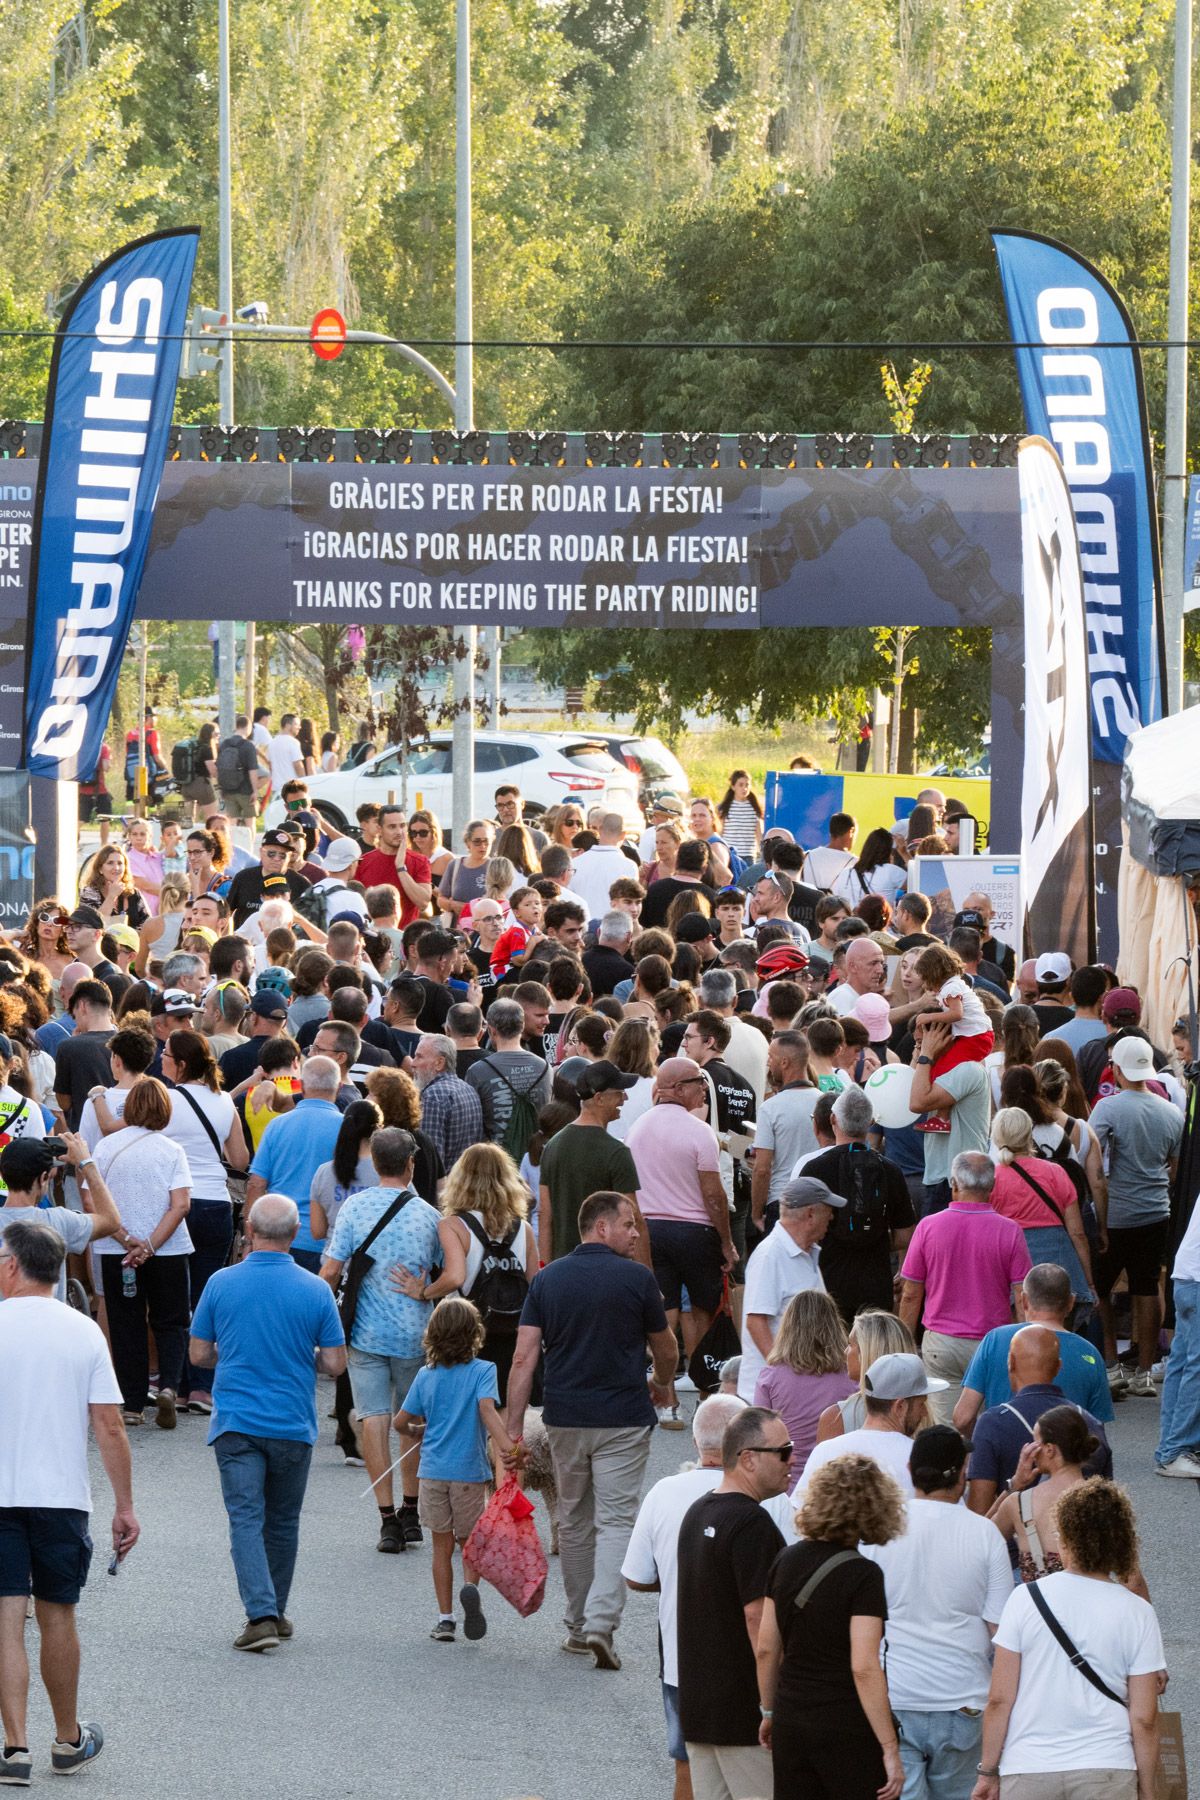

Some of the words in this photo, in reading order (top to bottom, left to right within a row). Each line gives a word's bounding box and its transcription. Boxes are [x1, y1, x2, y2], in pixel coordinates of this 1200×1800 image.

[329, 476, 425, 510] GRÀCIES
[432, 483, 475, 511] PER
[482, 483, 524, 511] FER
[531, 484, 607, 513] RODAR
[614, 485, 641, 513] LA
[649, 485, 723, 514] FESTA!
[30, 276, 164, 758] SHIMANO
[304, 530, 408, 560] ¡GRACIAS
[415, 532, 460, 560] POR
[468, 533, 542, 561] HACER
[549, 534, 625, 562] RODAR
[632, 535, 659, 563] LA
[667, 535, 748, 564] FIESTA!
[292, 580, 383, 609] THANKS
[390, 581, 433, 609] FOR
[440, 582, 537, 611] KEEPING
[543, 583, 587, 611] THE
[595, 584, 665, 612] PARTY
[671, 585, 757, 613] RIDING!
